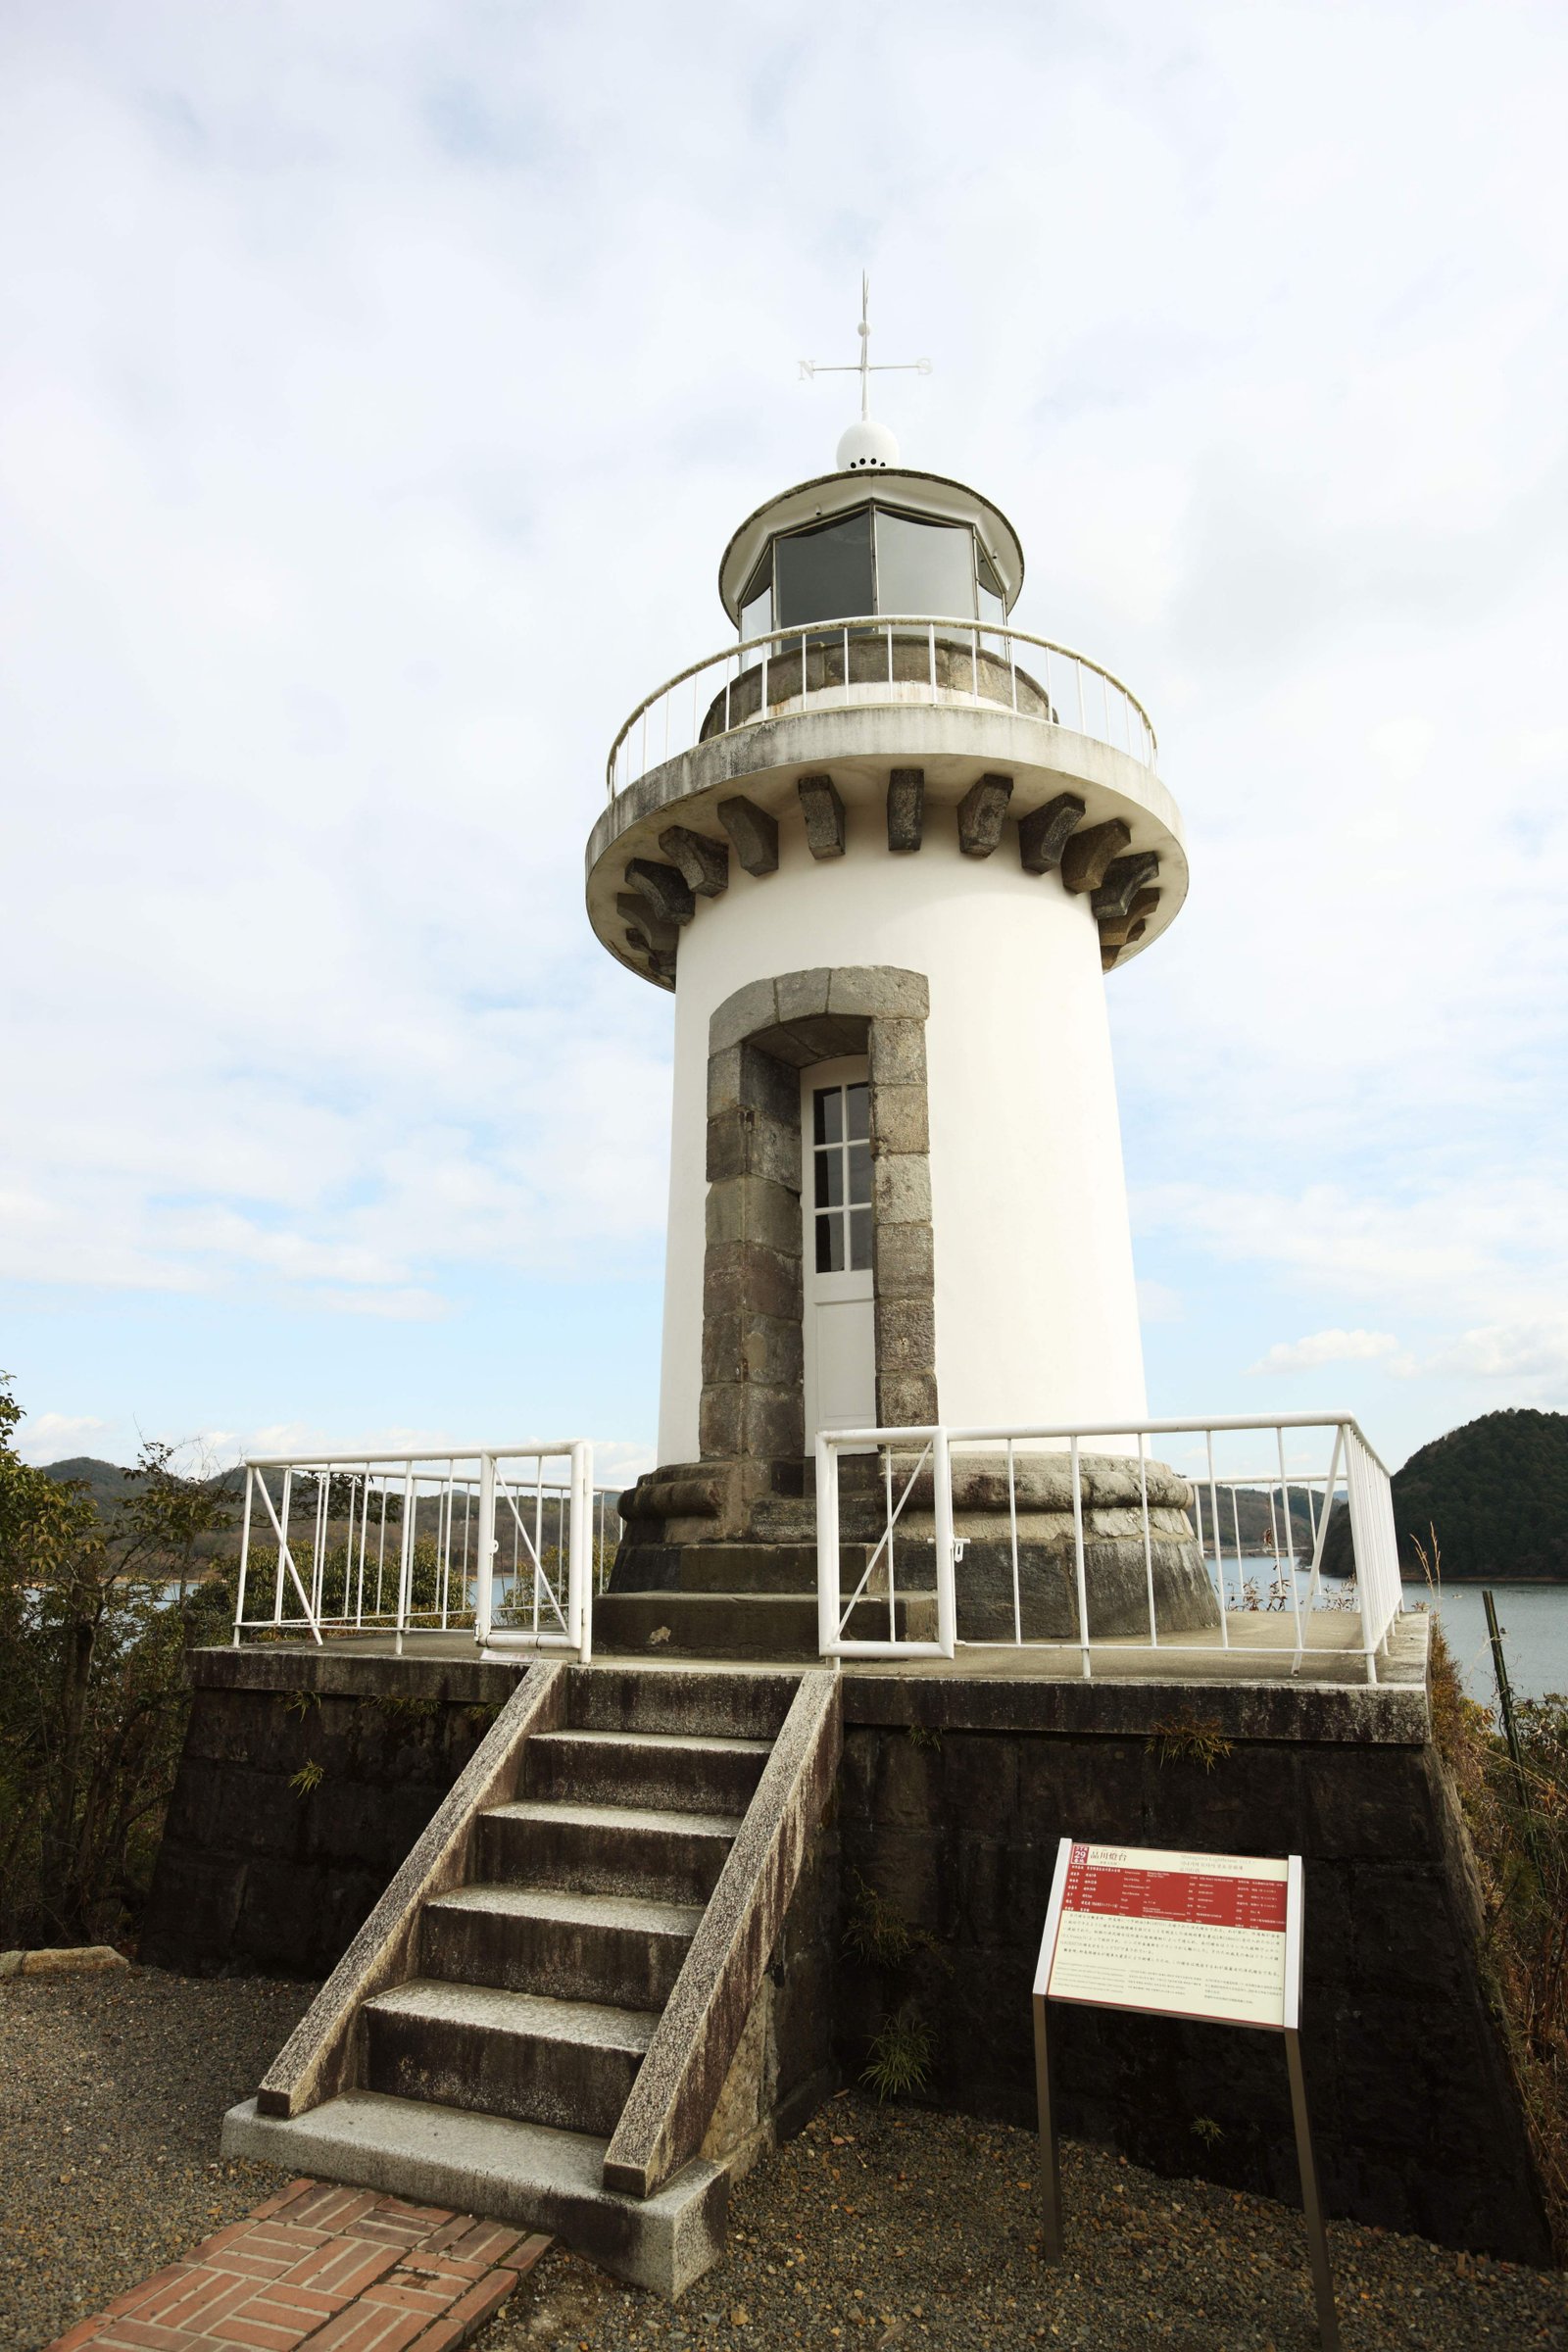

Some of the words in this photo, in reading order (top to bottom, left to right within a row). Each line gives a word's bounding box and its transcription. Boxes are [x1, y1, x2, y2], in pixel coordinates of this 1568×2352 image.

[798, 360, 815, 380] N
[916, 358, 933, 375] S
[1074, 1850, 1086, 1859] 29
